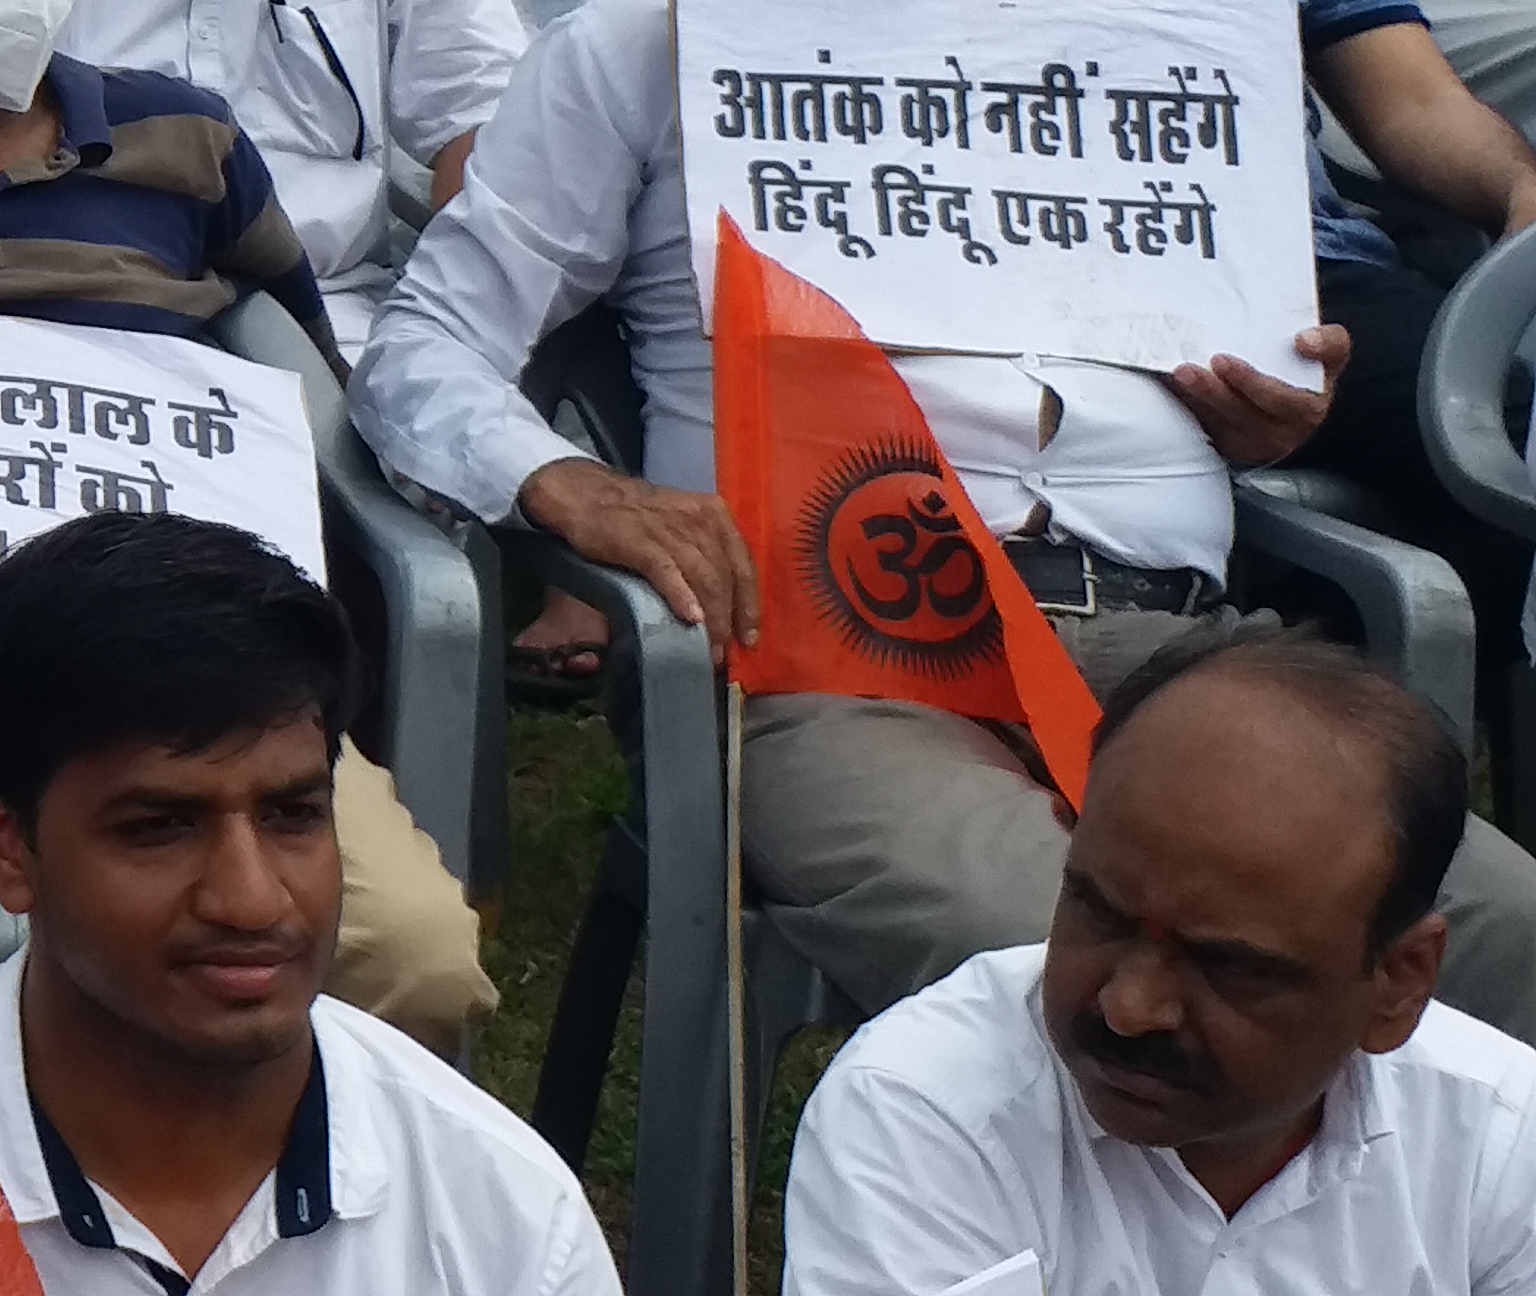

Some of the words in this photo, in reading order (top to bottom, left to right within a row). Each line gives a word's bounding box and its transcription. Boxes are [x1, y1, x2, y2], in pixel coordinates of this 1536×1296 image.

[712, 49, 884, 146] आतंक
[895, 55, 972, 150] को
[981, 60, 1100, 160] नहीं
[1105, 65, 1240, 166] सहेंगे
[748, 159, 876, 260] हिंदू
[872, 164, 997, 268] हिंदू
[991, 186, 1088, 250] एक
[1098, 181, 1217, 260] रहेंगे
[168, 388, 238, 458] के
[75, 460, 174, 513] को
